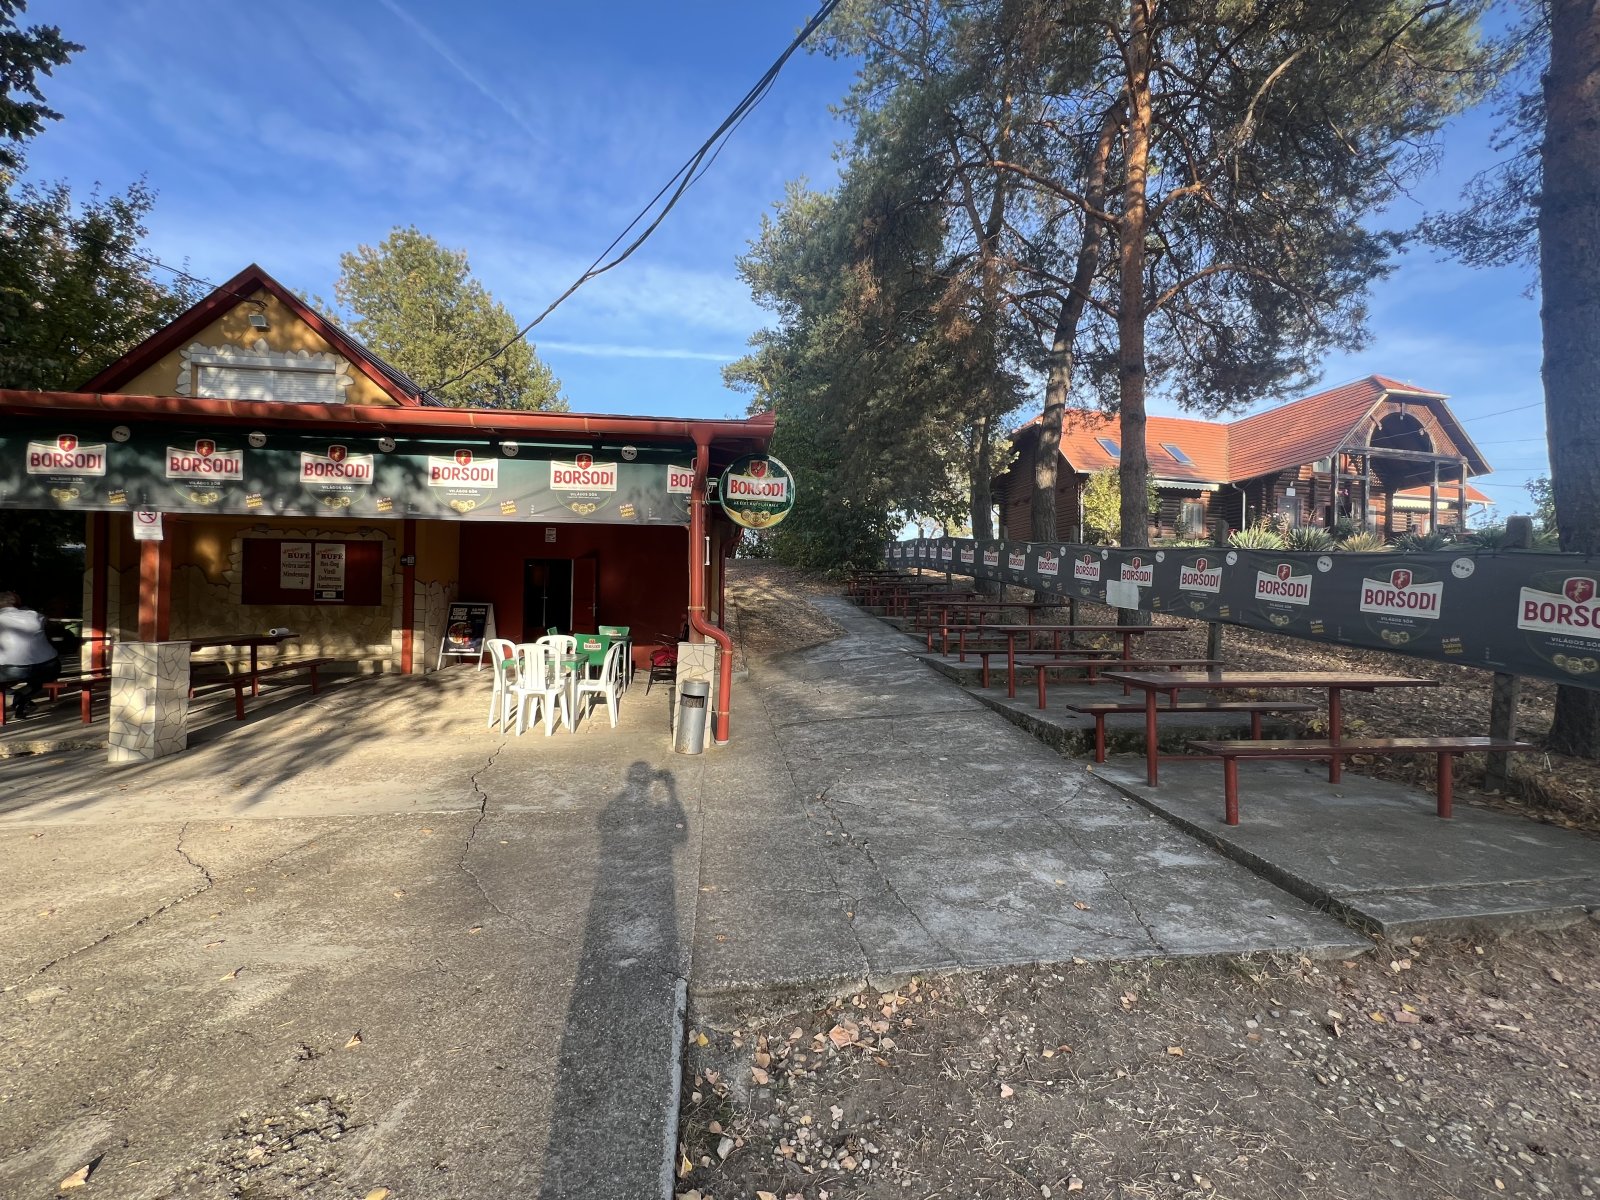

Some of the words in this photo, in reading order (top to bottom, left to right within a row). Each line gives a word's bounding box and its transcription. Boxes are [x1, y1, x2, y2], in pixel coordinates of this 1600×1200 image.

[30, 452, 103, 469] BORSODI
[169, 456, 239, 474] BORSODI
[304, 462, 370, 478] BORSODI
[431, 466, 494, 482] BORSODI
[553, 470, 614, 485] BORSODI
[730, 479, 784, 497] BORSODI
[1075, 565, 1099, 577] BORSODI
[1122, 569, 1152, 582] BORSODI
[1181, 573, 1219, 588] BORSODI
[1258, 579, 1308, 598] BORSODI
[1364, 588, 1437, 611] BORSODI
[1551, 636, 1585, 646] VILÁGOS
